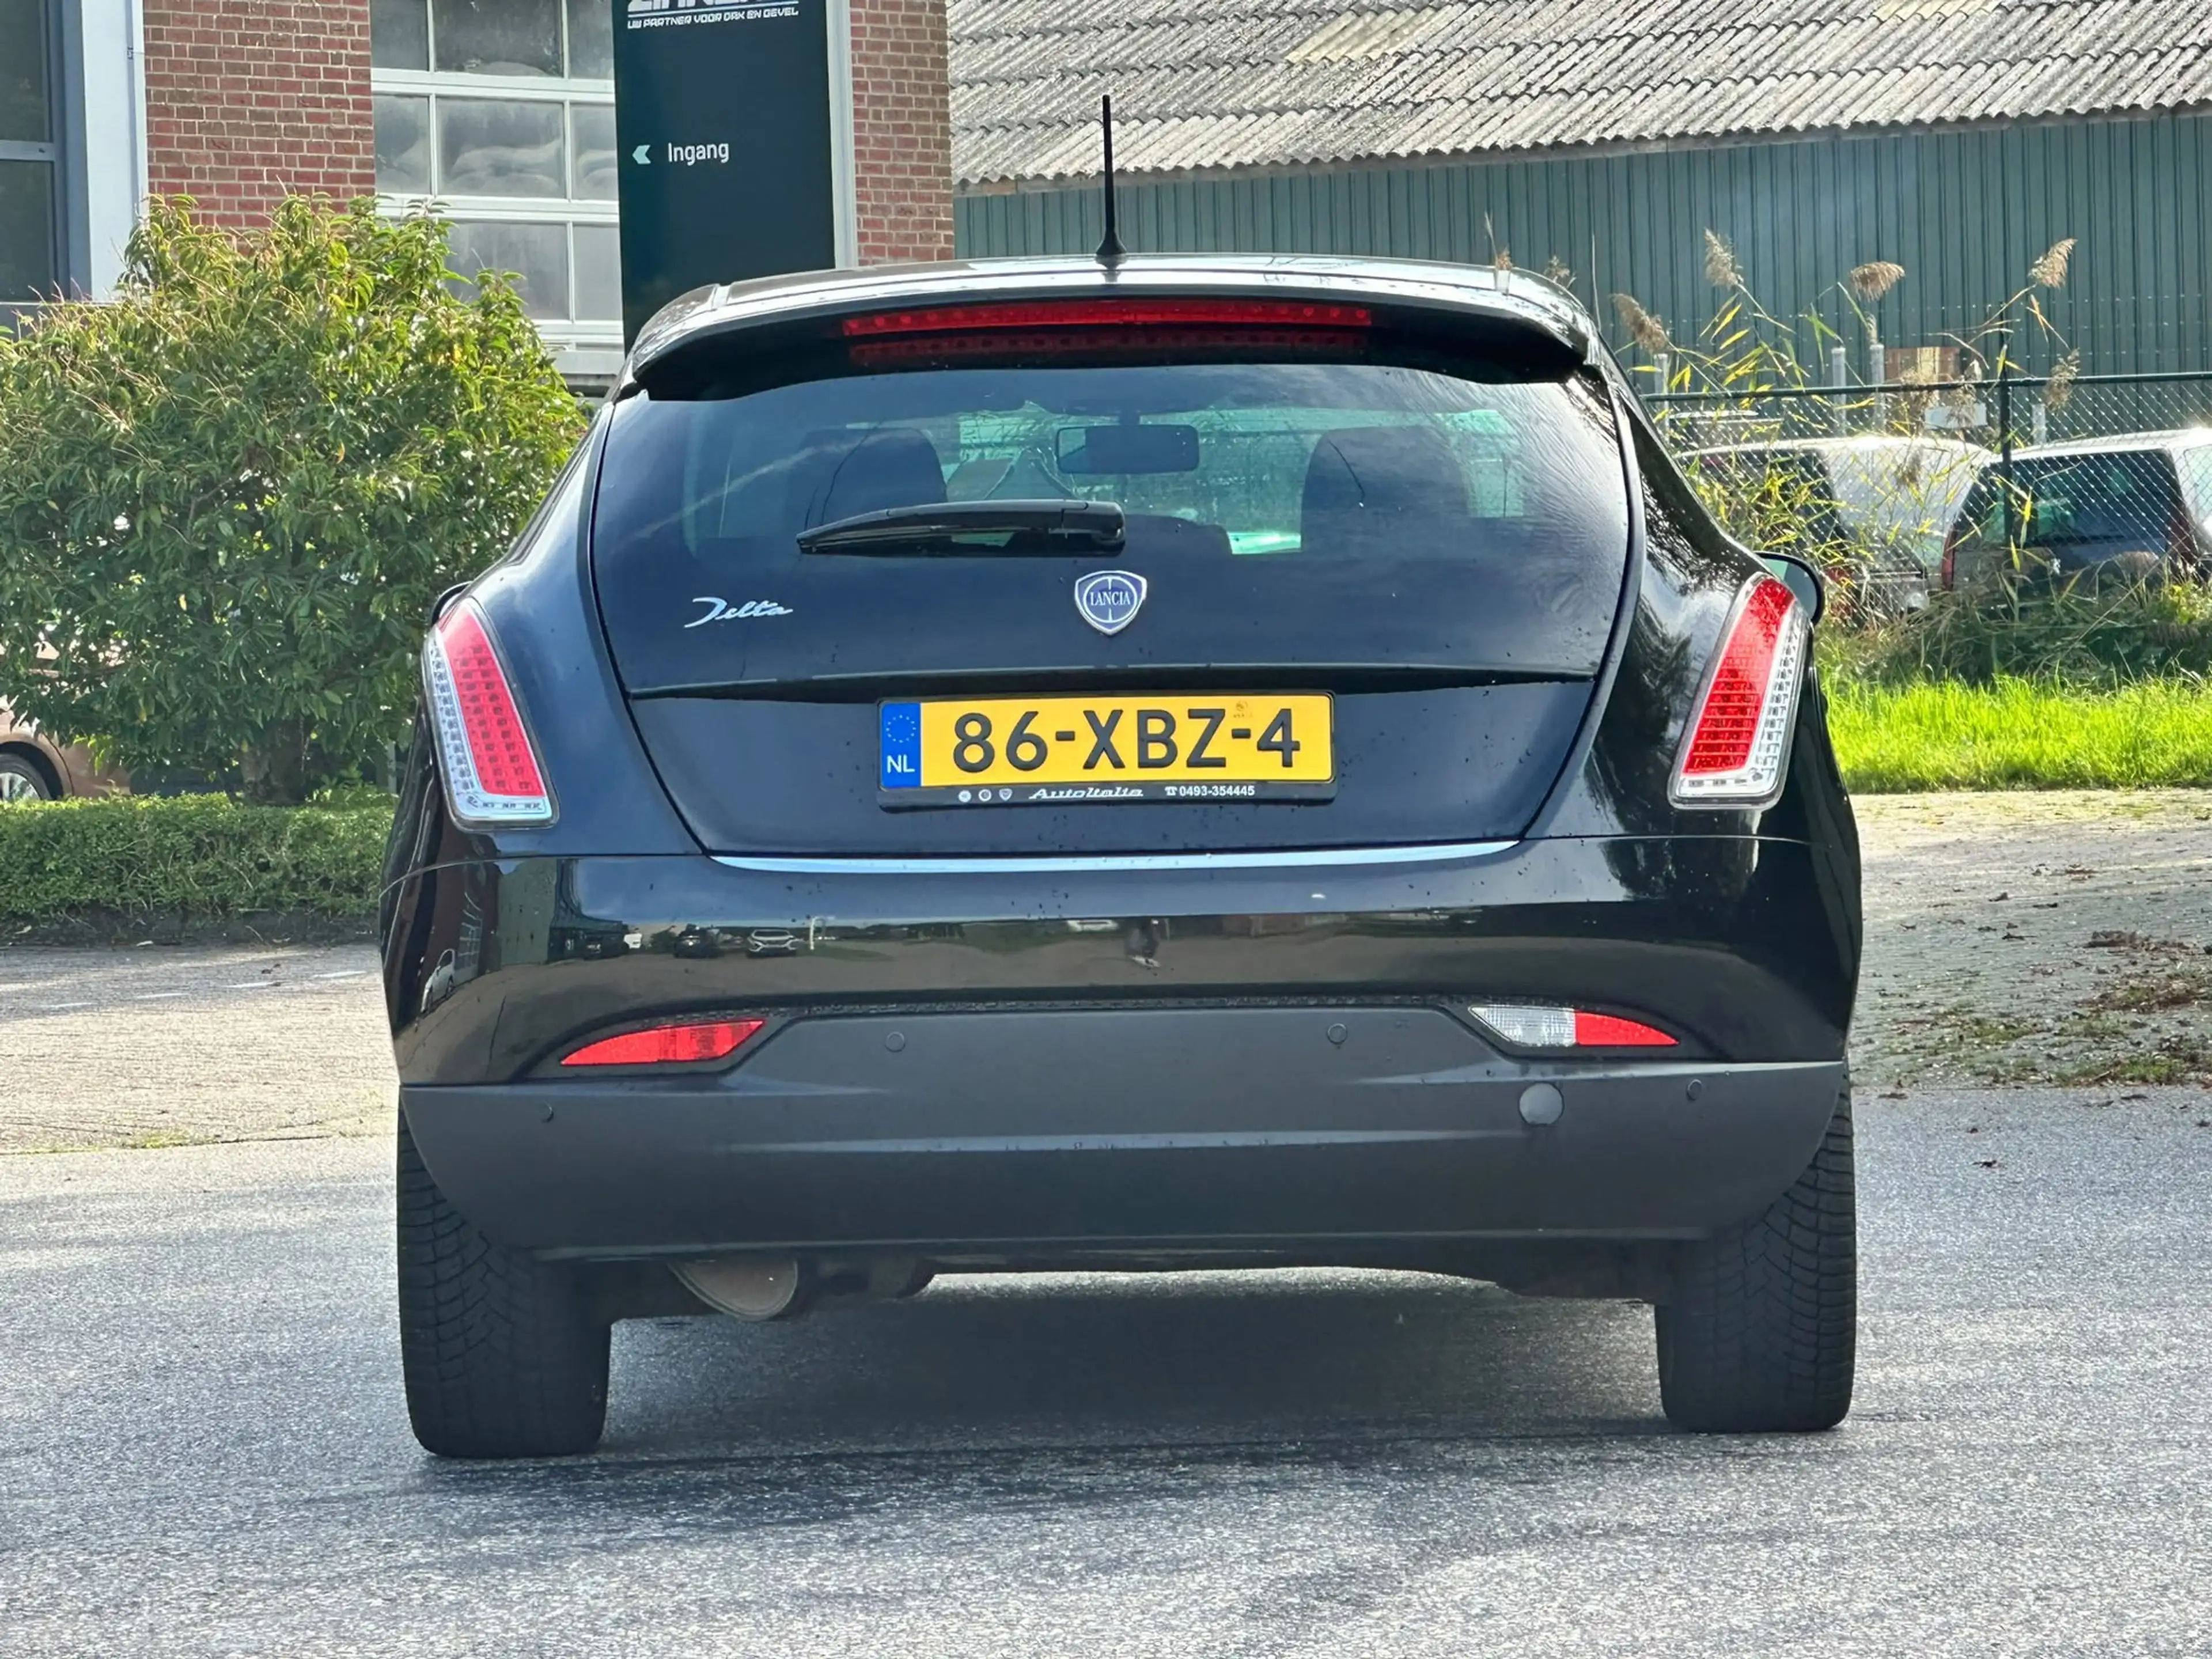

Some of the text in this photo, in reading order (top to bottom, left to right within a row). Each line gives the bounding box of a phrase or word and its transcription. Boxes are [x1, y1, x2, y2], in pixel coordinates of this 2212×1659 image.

[643, 16, 692, 28] PARTNER
[694, 13, 722, 24] VOOR
[724, 11, 745, 21] DAK
[747, 9, 762, 19] EN
[763, 7, 798, 18] GEVEL
[668, 142, 729, 166] Ingang
[1089, 590, 1131, 606] LANCIA
[684, 596, 793, 628] Delta
[953, 708, 1301, 773] 86-XBZ-4
[887, 755, 915, 773] NL
[1179, 785, 1255, 797] 0493-354445
